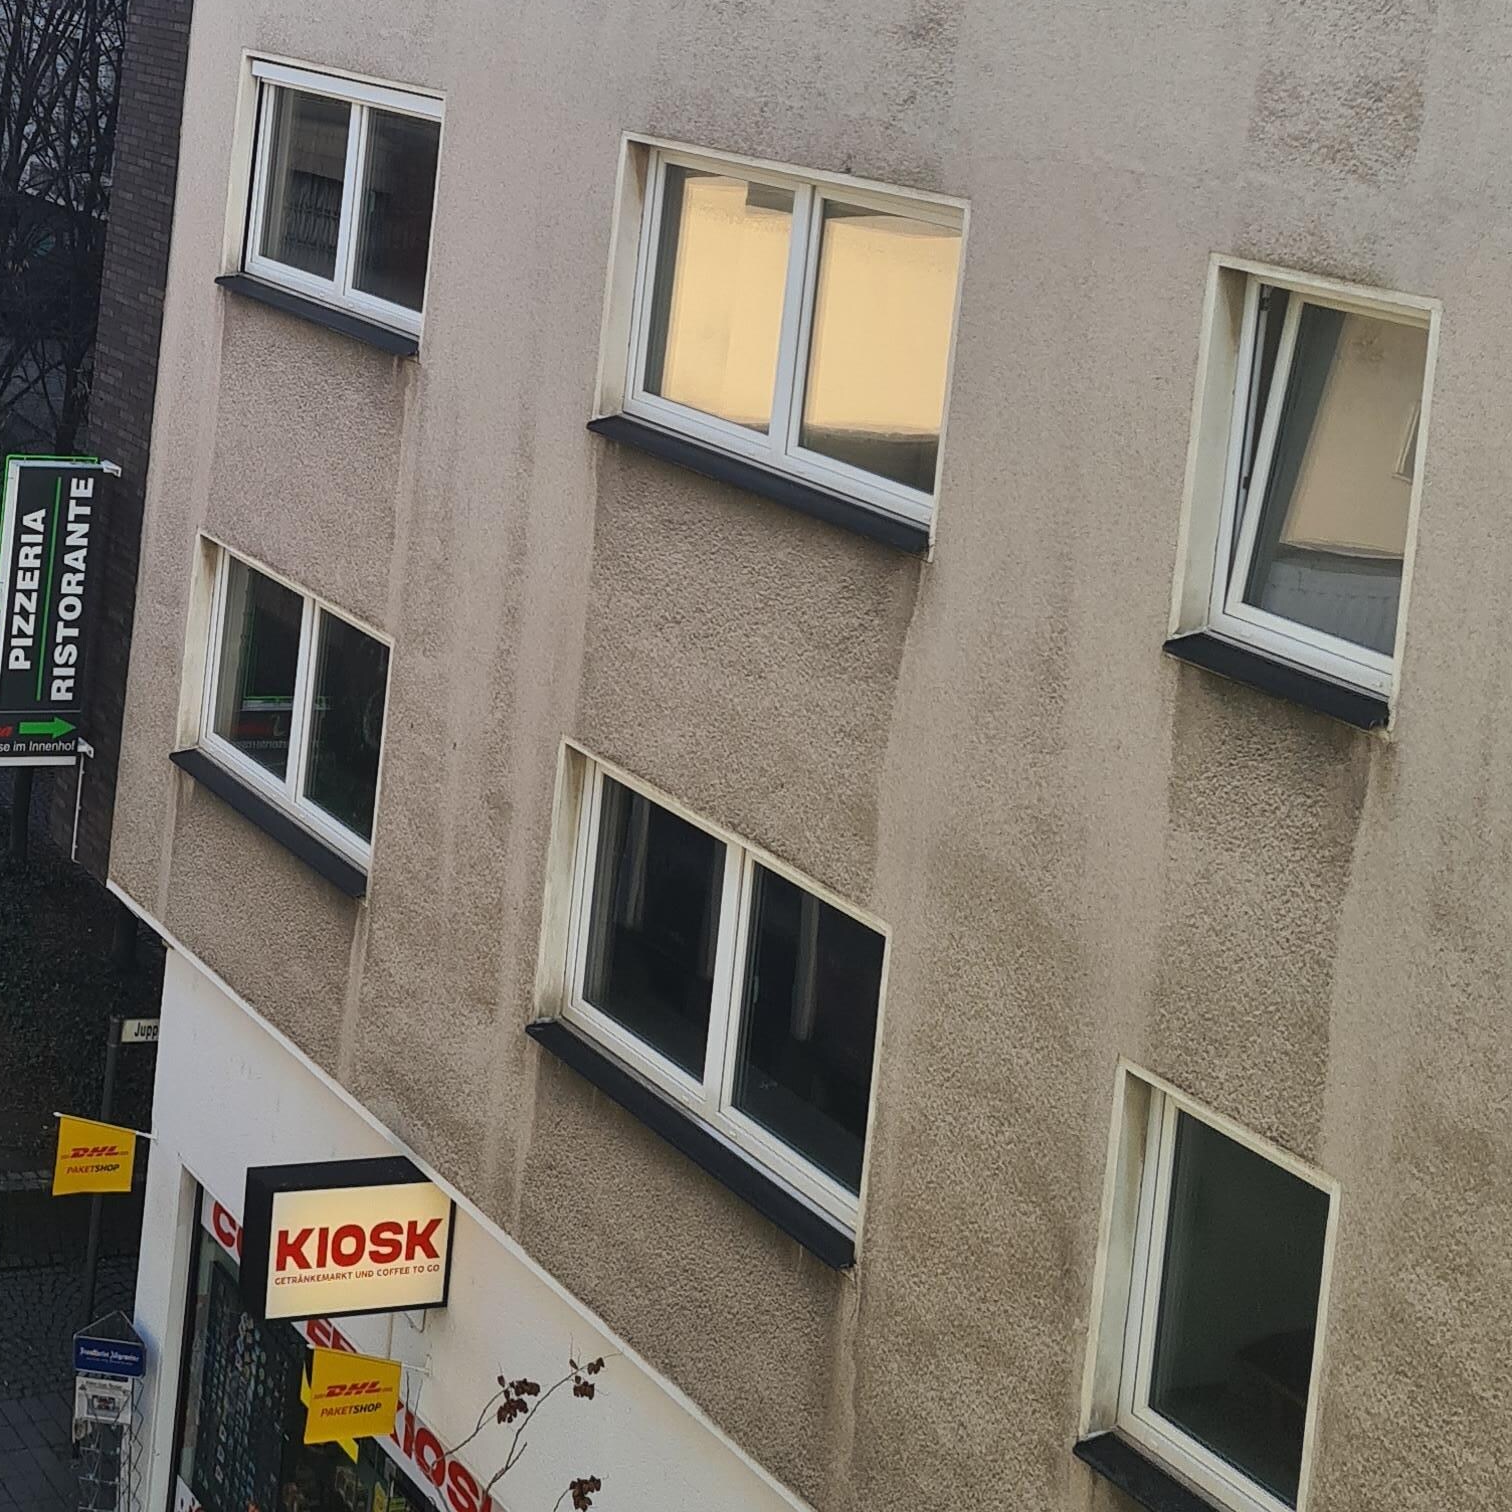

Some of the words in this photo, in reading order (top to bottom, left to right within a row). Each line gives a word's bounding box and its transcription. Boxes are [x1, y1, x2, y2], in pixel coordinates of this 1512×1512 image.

[8, 508, 47, 670] PIZZERIA
[50, 477, 95, 701] RISTORANTE
[13, 741, 26, 752] im
[29, 739, 76, 751] Innenhof
[70, 1145, 119, 1159] DHL
[66, 1163, 120, 1175] PAKETSHOP
[275, 1218, 444, 1272] KIOSK
[274, 1271, 354, 1286] GETRÄNKEMARKT
[355, 1269, 374, 1279] UND
[376, 1266, 410, 1277] COFFEE
[412, 1265, 425, 1274] TO
[426, 1263, 441, 1273] GO
[325, 1380, 382, 1398] DHL
[320, 1402, 383, 1418] PAKETSHOP
